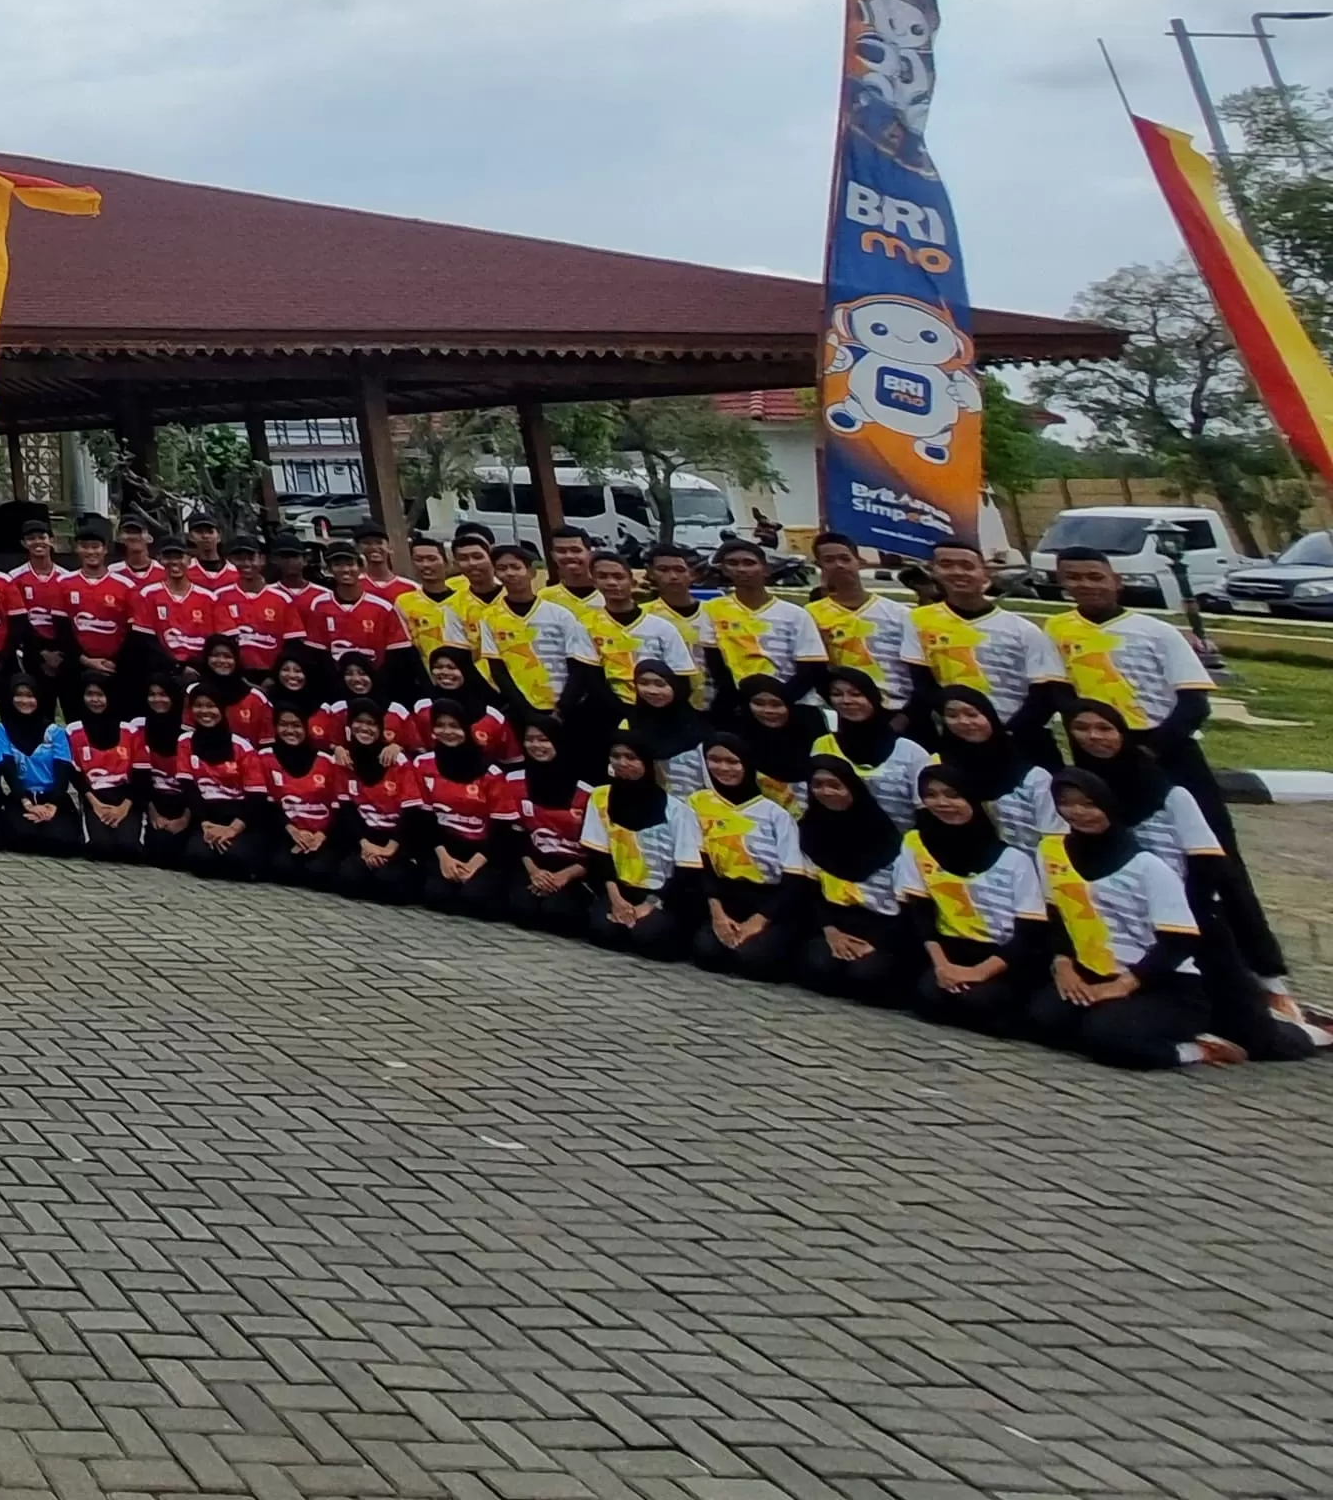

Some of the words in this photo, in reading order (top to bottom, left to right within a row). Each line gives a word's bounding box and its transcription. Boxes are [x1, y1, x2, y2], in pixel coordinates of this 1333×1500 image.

[846, 180, 946, 246] BRI
[861, 232, 952, 273] mo
[884, 374, 924, 397] BRI
[891, 392, 926, 407] mo
